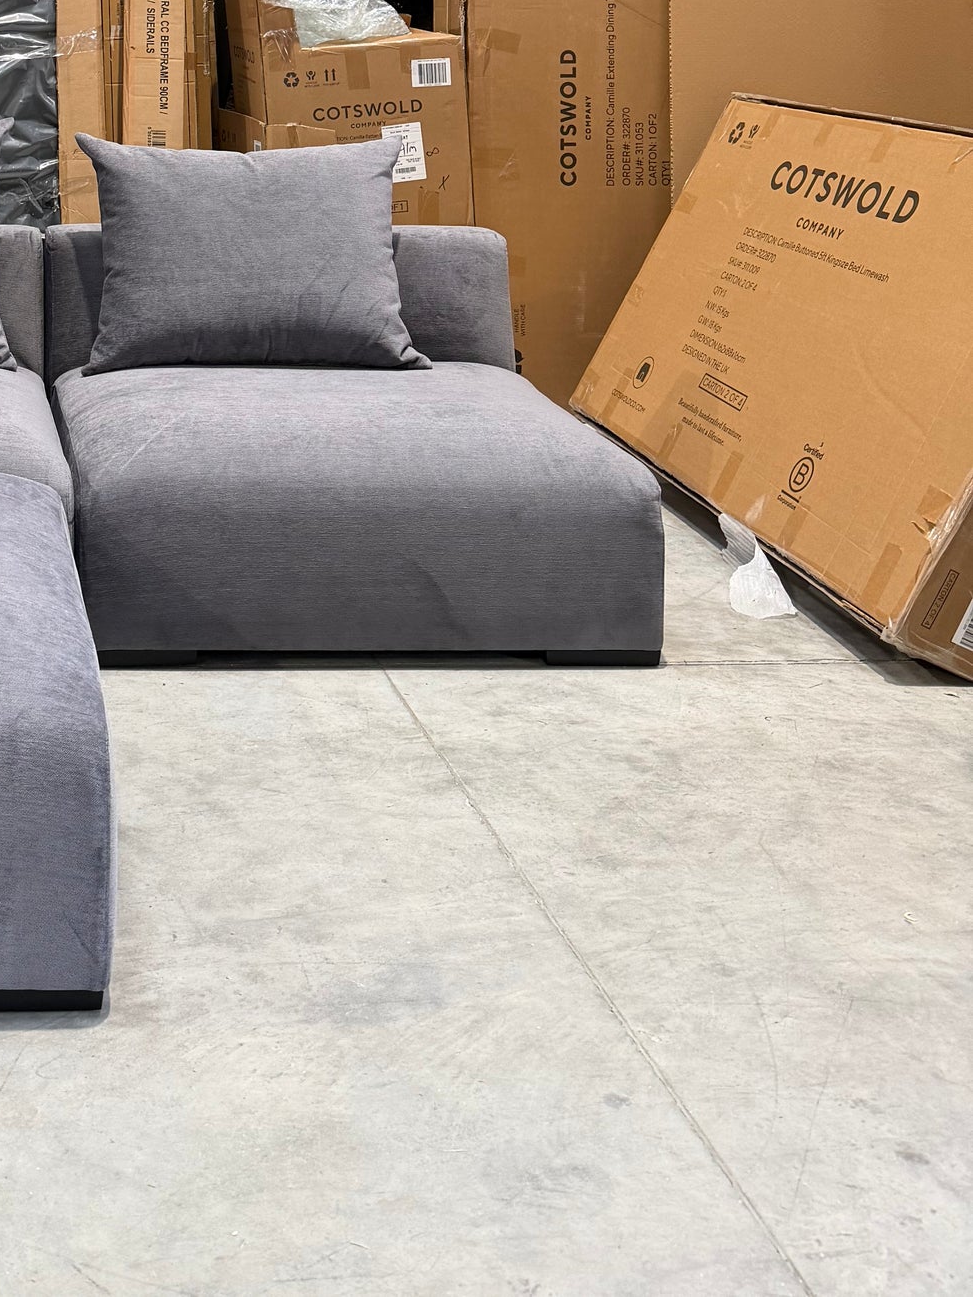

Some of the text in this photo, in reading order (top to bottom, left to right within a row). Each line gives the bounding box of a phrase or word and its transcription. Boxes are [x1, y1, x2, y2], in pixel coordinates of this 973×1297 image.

[146, 7, 156, 54] SIDERAILS
[160, 20, 169, 33] CC
[605, 2, 617, 33] Dining
[159, 35, 169, 84] BEDFRAME
[605, 34, 617, 80] Extending
[159, 86, 169, 110] 90CM
[313, 99, 423, 122] COTSWOLD
[605, 82, 615, 116] Camille
[350, 121, 387, 129] COMPANY
[559, 49, 577, 187] COTSWOLD
[605, 117, 615, 187] DESCRIPTION:
[622, 106, 631, 186] ORDER#: 322870
[635, 122, 644, 187] SKU#: 311.053
[648, 140, 657, 186] CARTON:
[770, 160, 920, 224] COTSWOLD
[795, 217, 845, 240] COMPANY
[756, 248, 777, 264] 322870
[777, 238, 796, 252] Camille
[794, 243, 819, 259] Buttoned
[826, 253, 849, 270] Kingsize
[847, 261, 861, 273] Bed
[859, 265, 889, 283] Limewash
[681, 343, 708, 362] DESIGNED
[710, 358, 722, 371] THE
[720, 364, 730, 374] UK
[702, 377, 744, 406] CARTON 2 OF 4
[803, 443, 825, 460] Certified
[793, 462, 809, 486] B
[938, 573, 956, 602] CARTON
